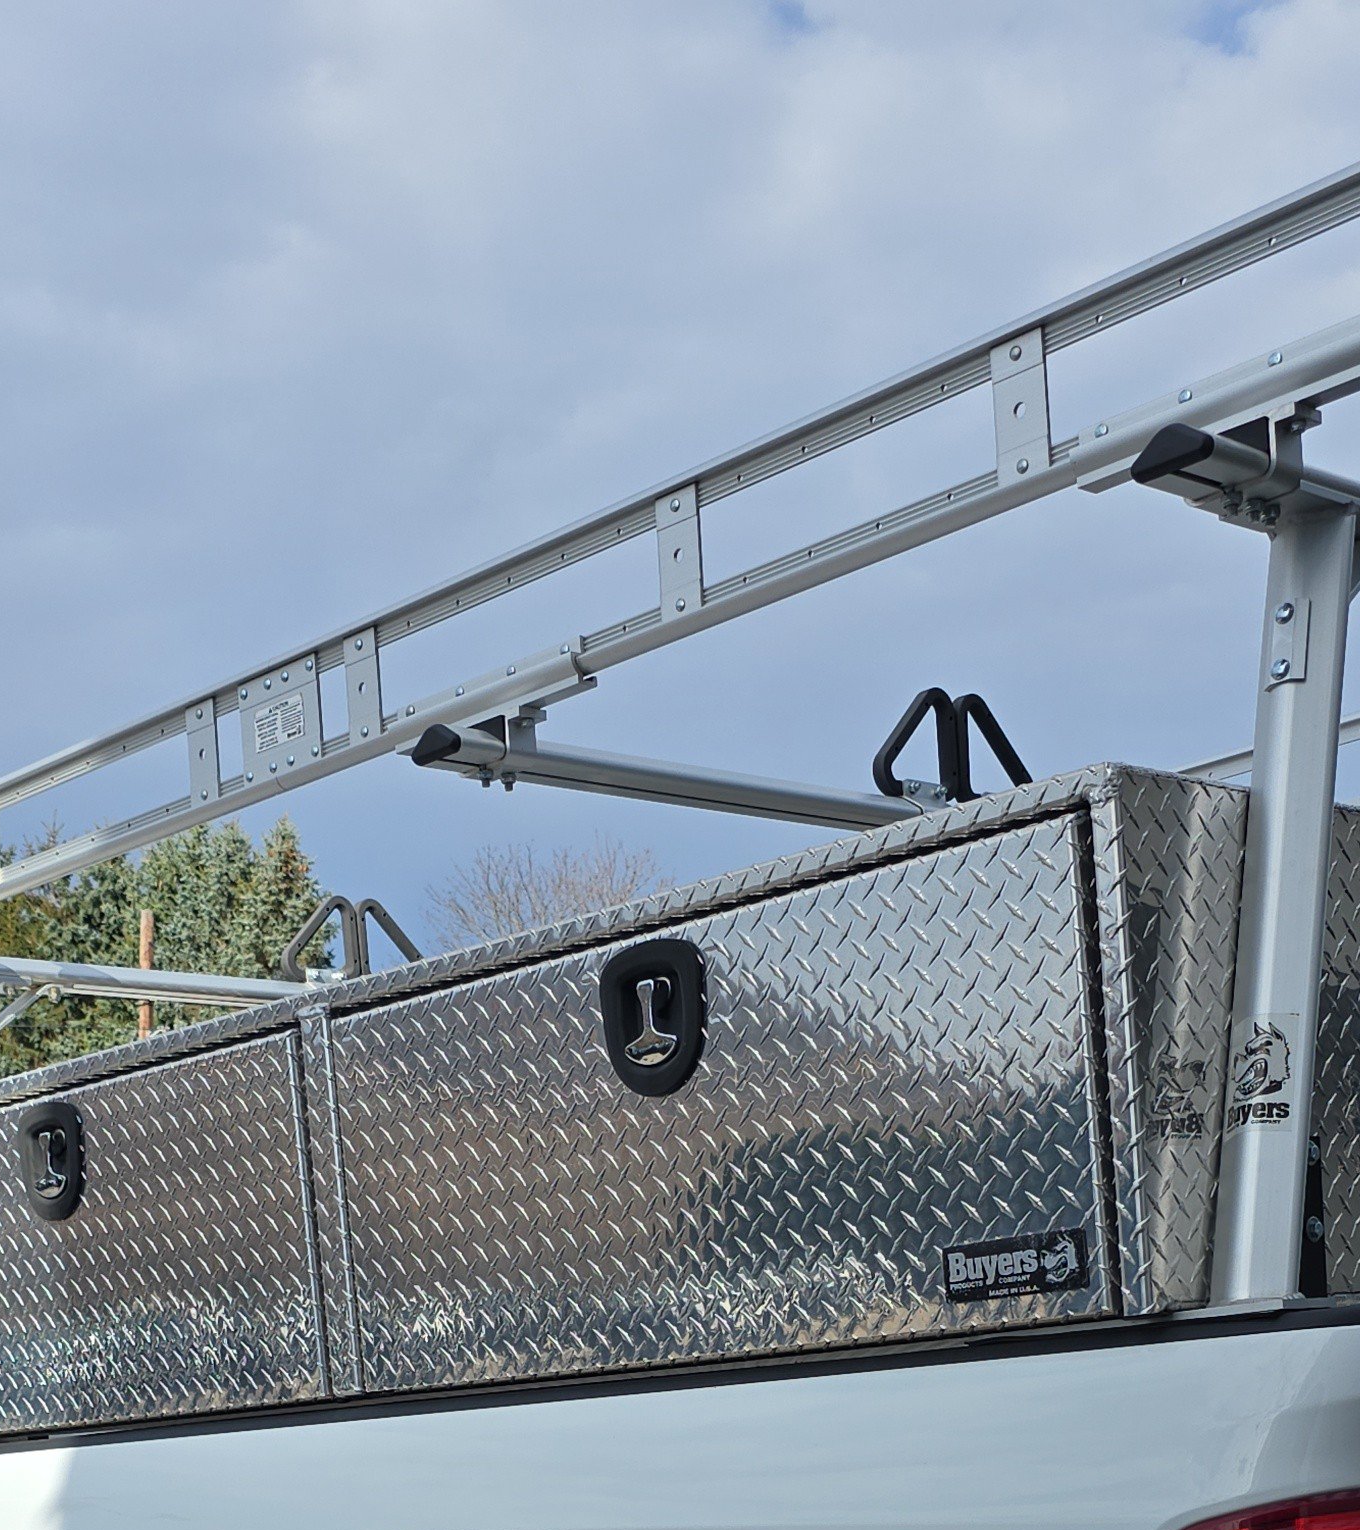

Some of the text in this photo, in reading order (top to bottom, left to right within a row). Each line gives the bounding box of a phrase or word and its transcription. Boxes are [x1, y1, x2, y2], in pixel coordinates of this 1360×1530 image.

[1227, 1103, 1290, 1129] Buyers
[947, 1249, 1038, 1285] Buyers
[950, 1274, 1031, 1291] PRODUCTS COMPANY
[988, 1288, 1009, 1297] MADE
